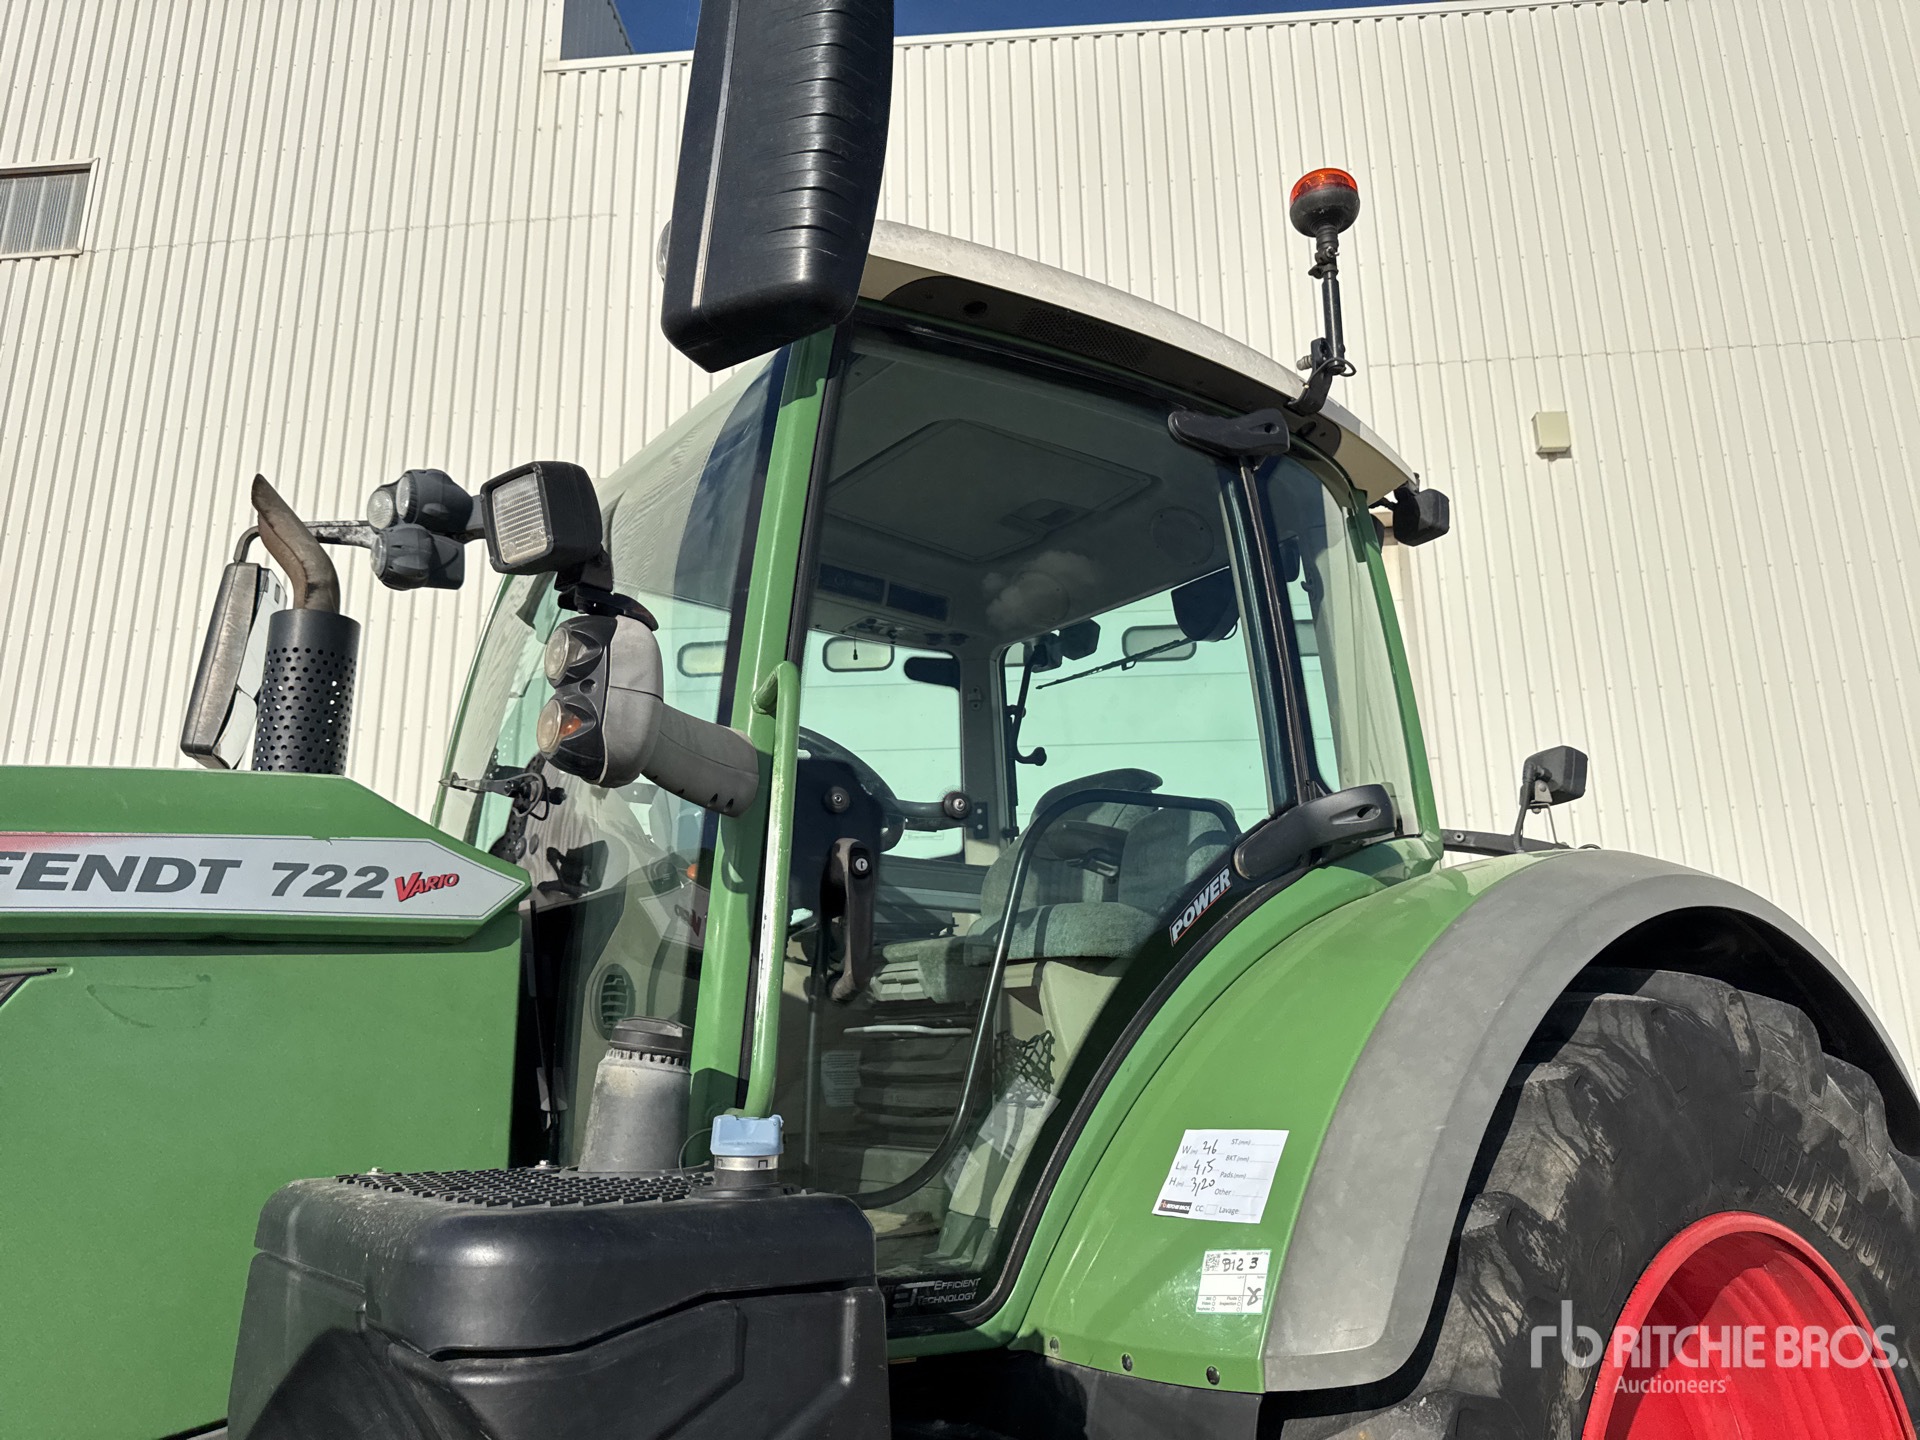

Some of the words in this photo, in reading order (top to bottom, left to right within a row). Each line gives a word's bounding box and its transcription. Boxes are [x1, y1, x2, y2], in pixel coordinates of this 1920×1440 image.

[271, 863, 390, 898] 722
[395, 872, 460, 902] VARIO
[1172, 868, 1231, 942] POWER
